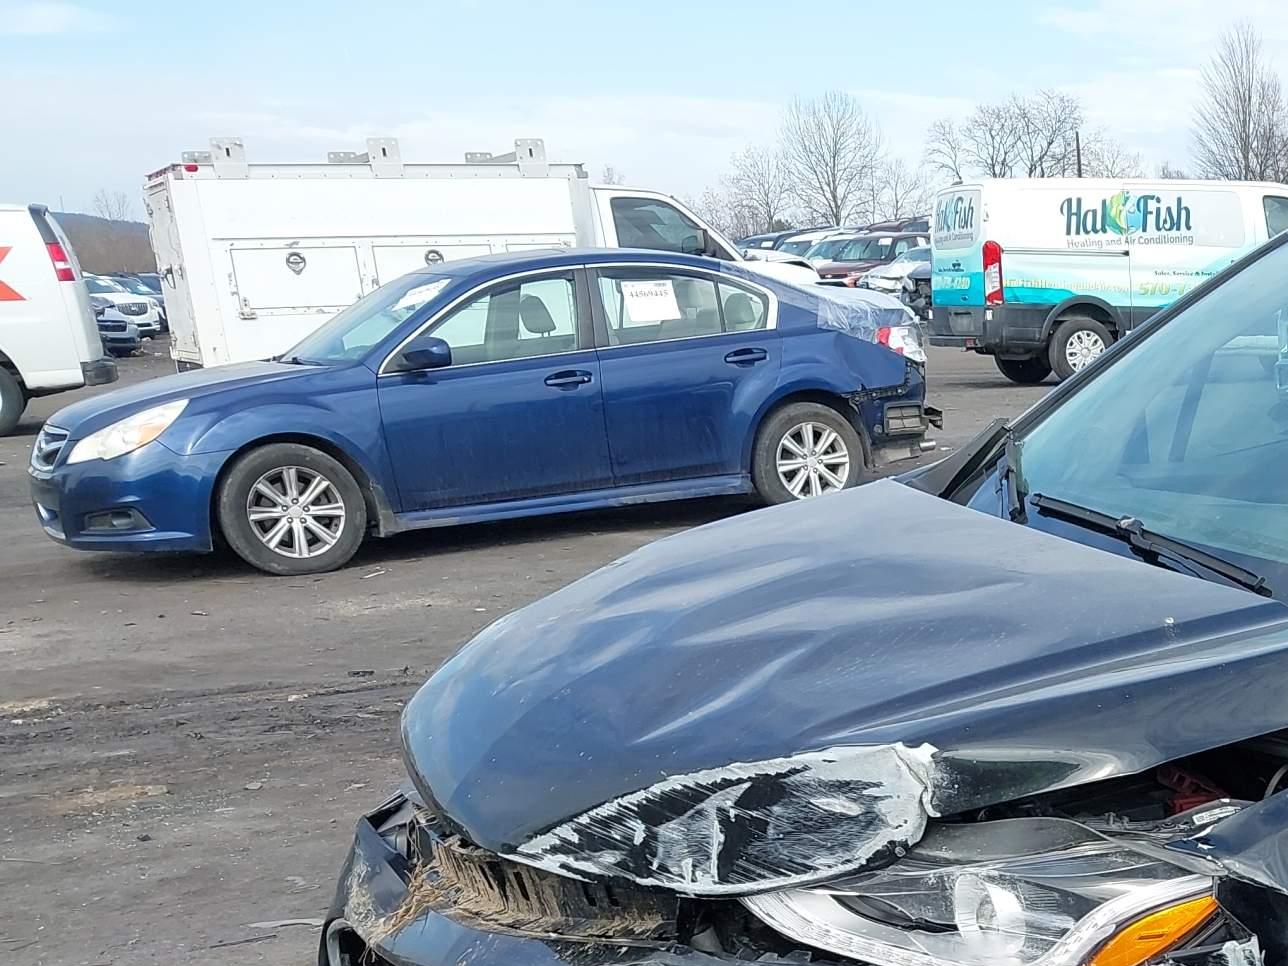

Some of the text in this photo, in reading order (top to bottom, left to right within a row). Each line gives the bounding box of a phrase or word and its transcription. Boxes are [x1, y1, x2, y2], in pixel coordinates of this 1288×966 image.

[1060, 194, 1192, 236] Hal Fish
[1066, 233, 1194, 249] Heating and Air Conditioning
